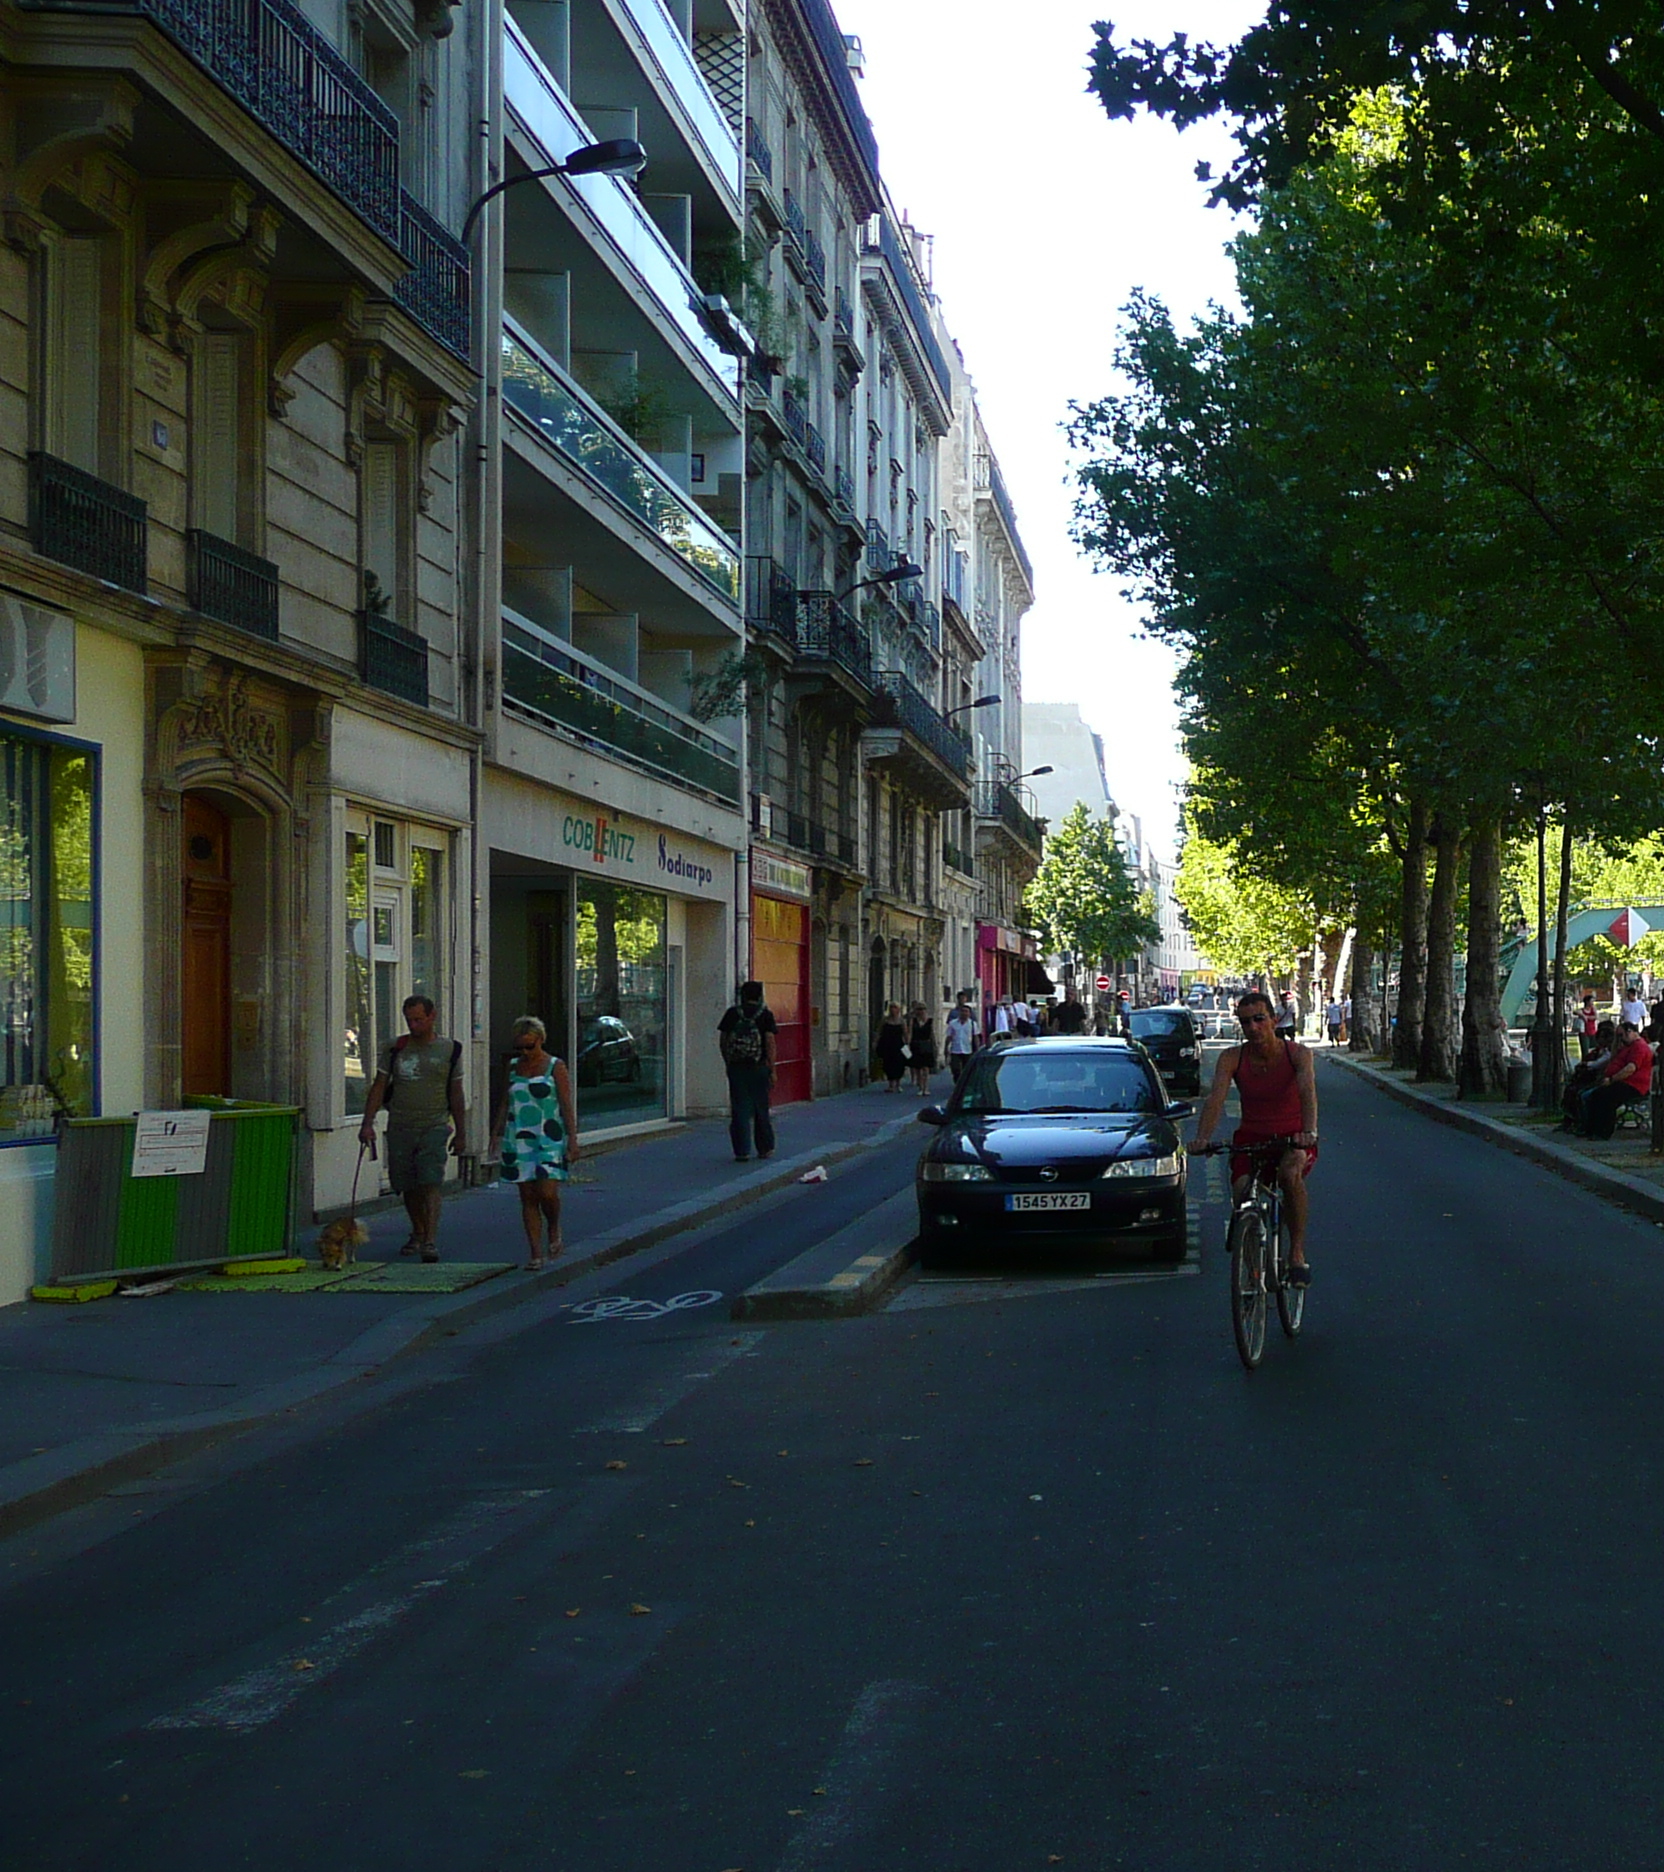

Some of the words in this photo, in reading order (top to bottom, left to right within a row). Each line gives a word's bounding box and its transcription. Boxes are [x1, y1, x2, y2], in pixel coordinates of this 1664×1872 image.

[563, 816, 635, 863] COBLENTZ
[657, 833, 712, 887] Sodiarpo
[1015, 1196, 1048, 1209] 1545
[1051, 1195, 1068, 1207] YX
[1070, 1194, 1087, 1207] 27
